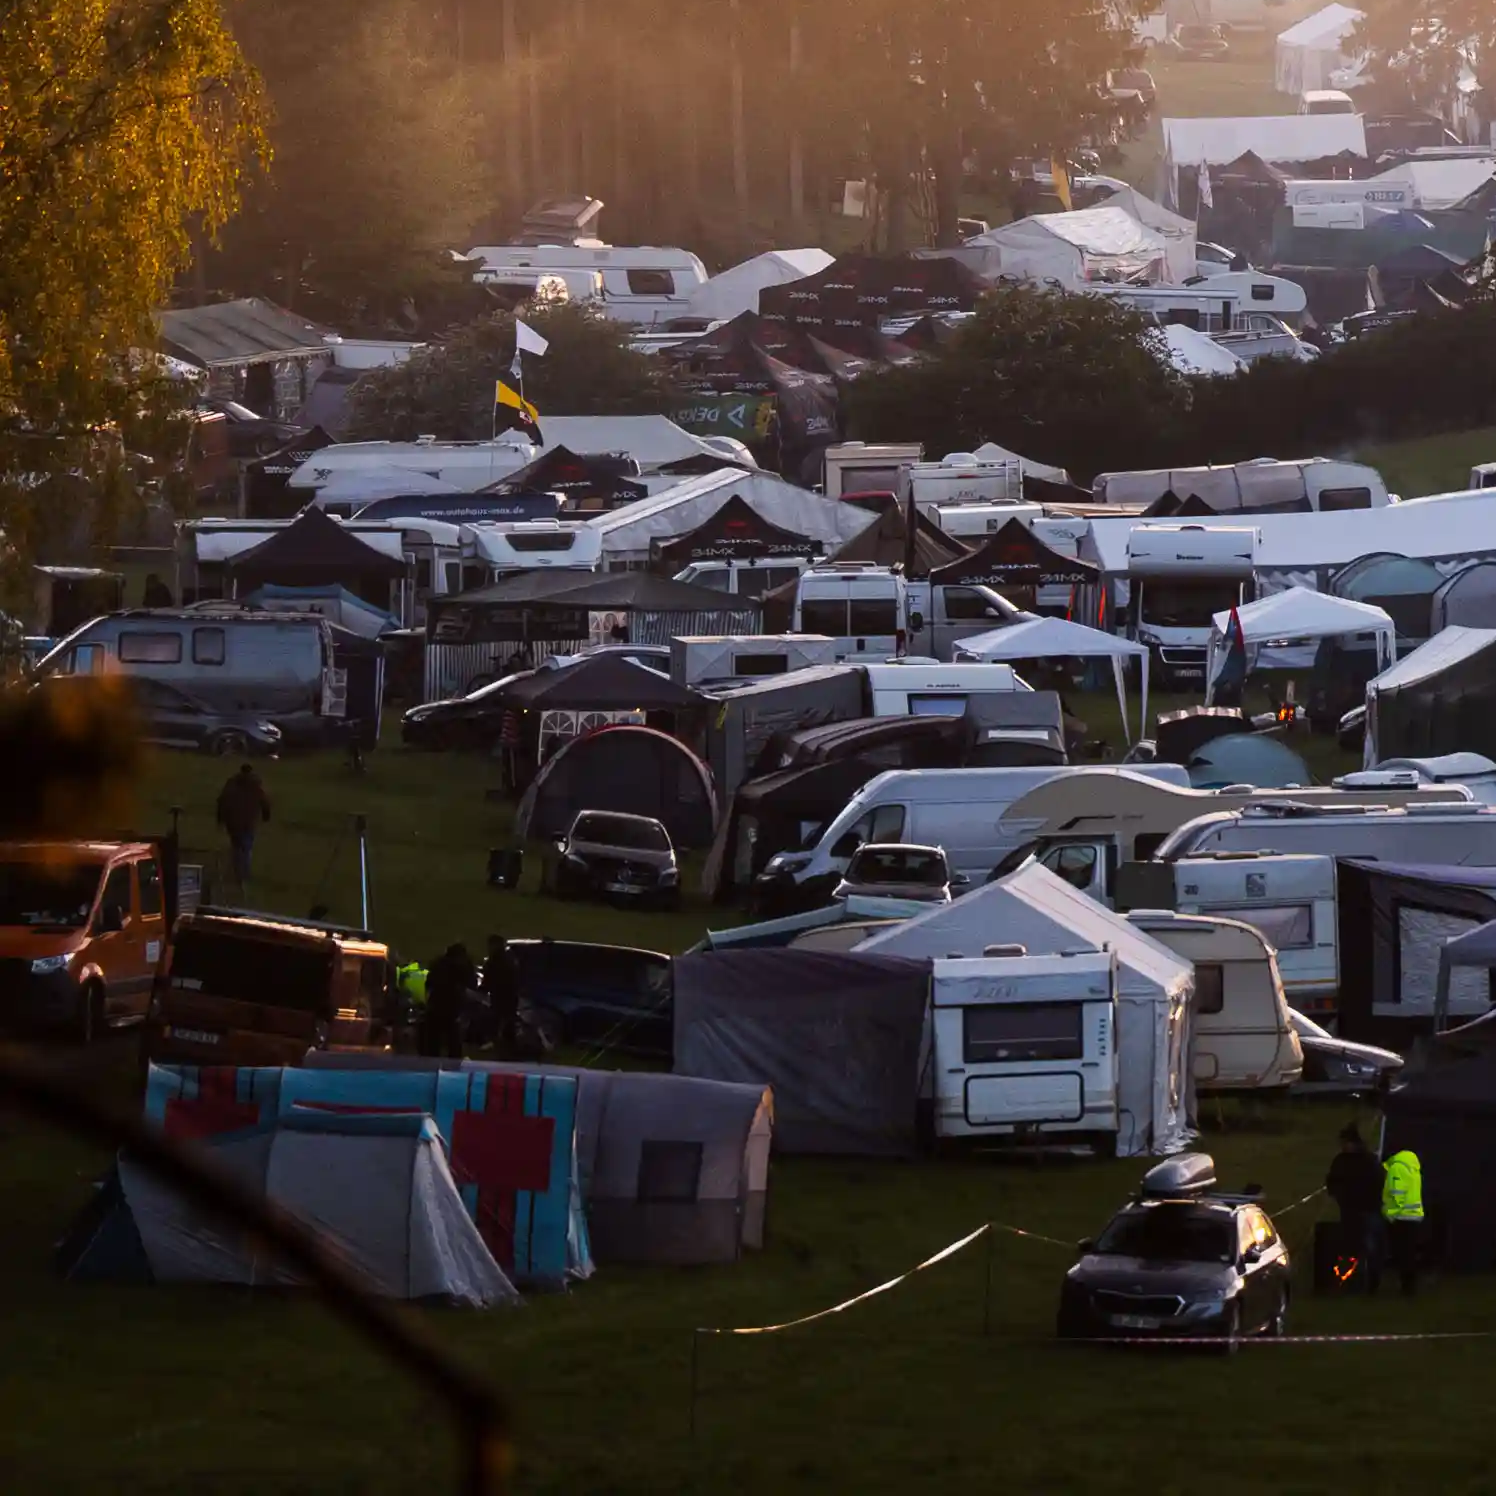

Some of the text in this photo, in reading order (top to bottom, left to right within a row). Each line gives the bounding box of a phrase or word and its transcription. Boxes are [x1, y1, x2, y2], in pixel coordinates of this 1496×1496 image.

[691, 547, 736, 557] 24MX
[768, 544, 812, 554] 24MX
[960, 575, 1005, 585] 24MX
[1039, 573, 1087, 582] 24MX
